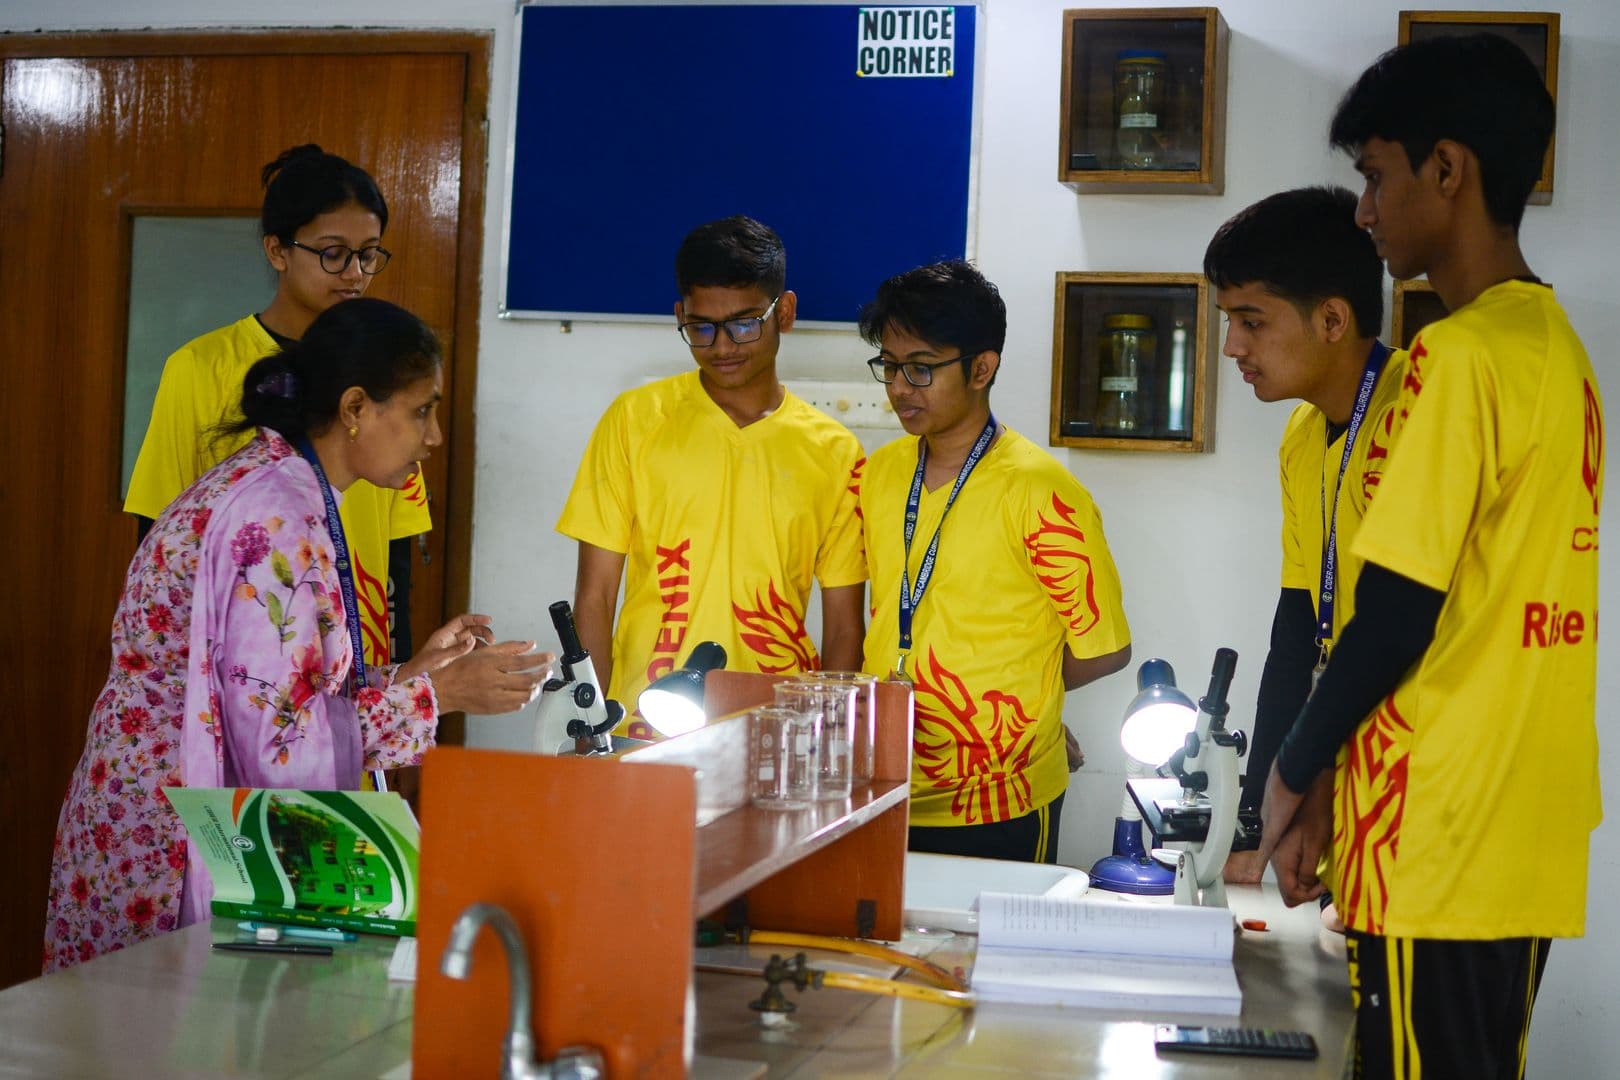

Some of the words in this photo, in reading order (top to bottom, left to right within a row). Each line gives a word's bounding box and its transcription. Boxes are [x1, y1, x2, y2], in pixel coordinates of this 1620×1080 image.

[863, 10, 952, 40] NOTICE
[860, 46, 951, 75] CORNER
[1358, 370, 1376, 413] CURRICULUM
[972, 425, 995, 458] CURRICULUM
[628, 538, 691, 741] POENIX
[1522, 602, 1585, 648] Rise
